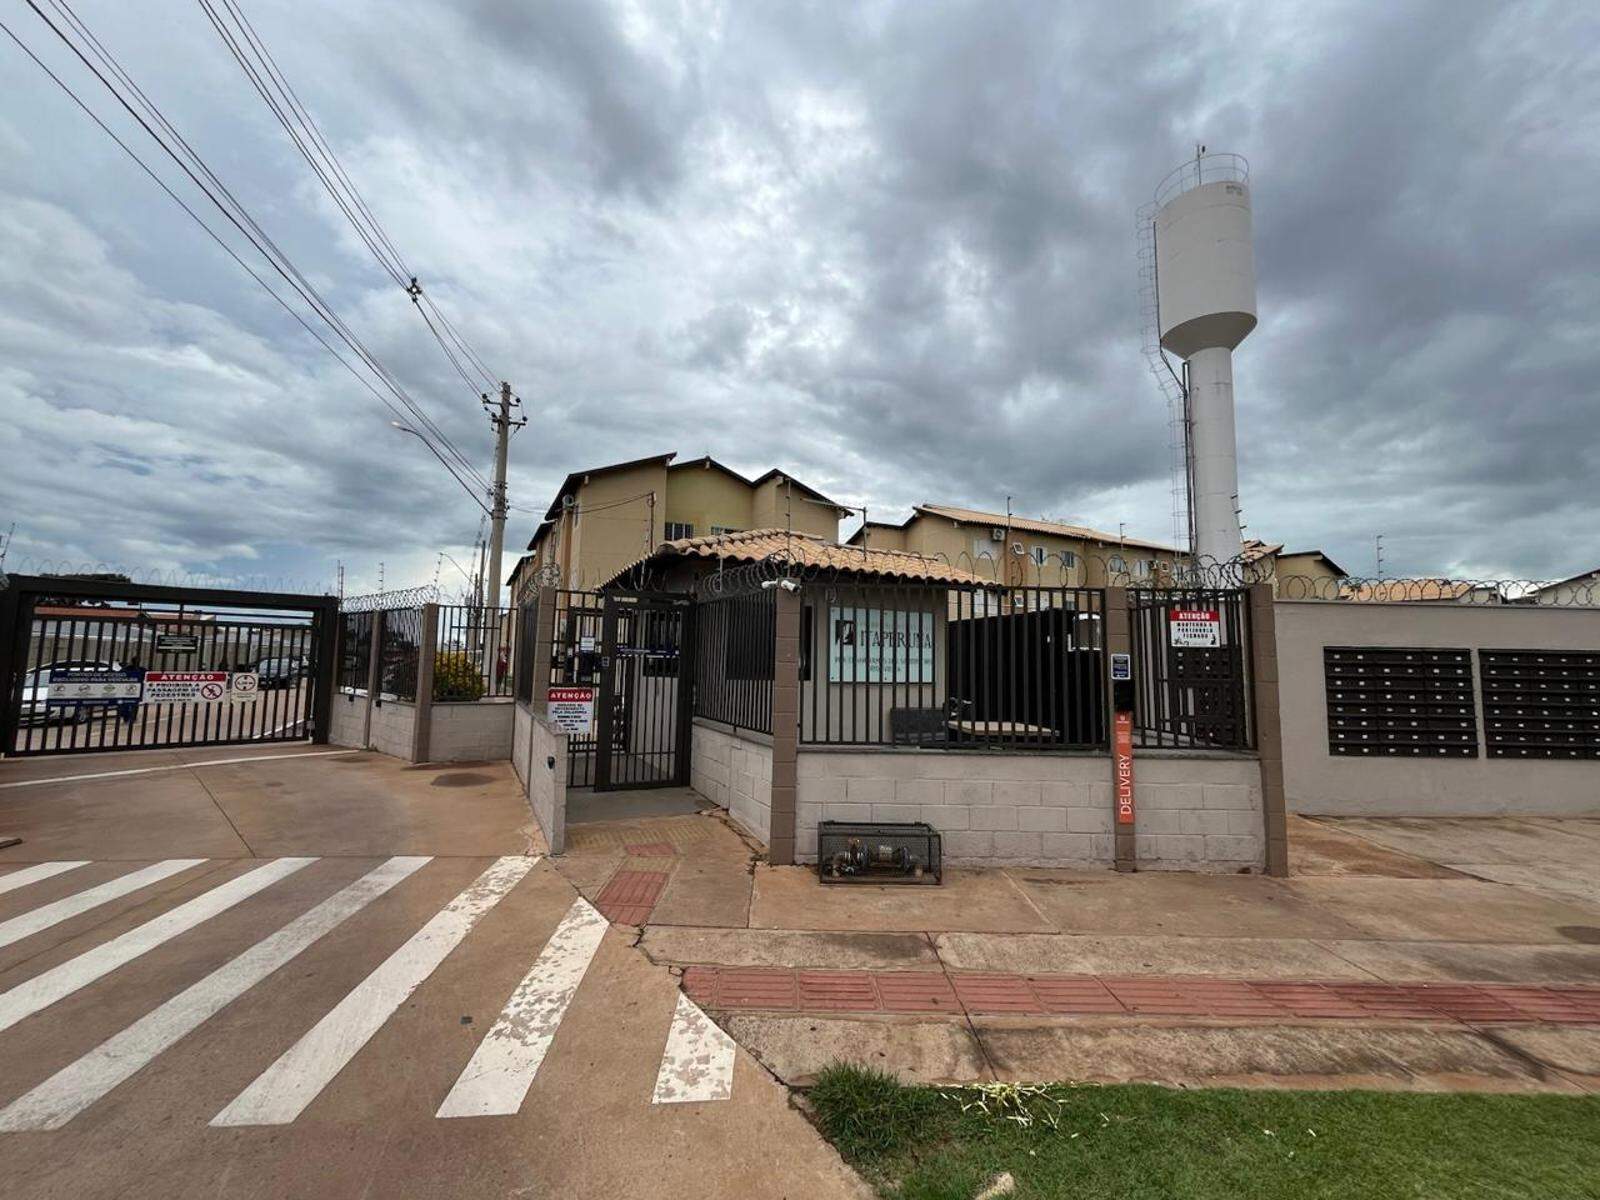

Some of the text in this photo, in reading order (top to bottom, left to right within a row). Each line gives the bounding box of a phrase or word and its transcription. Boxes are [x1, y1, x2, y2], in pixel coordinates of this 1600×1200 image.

[1178, 611, 1211, 620] ATENÇÃO
[160, 673, 215, 681] ATENÇÃO
[550, 691, 592, 699] ATENÇÃO
[1119, 754, 1132, 815] DELIVERY
